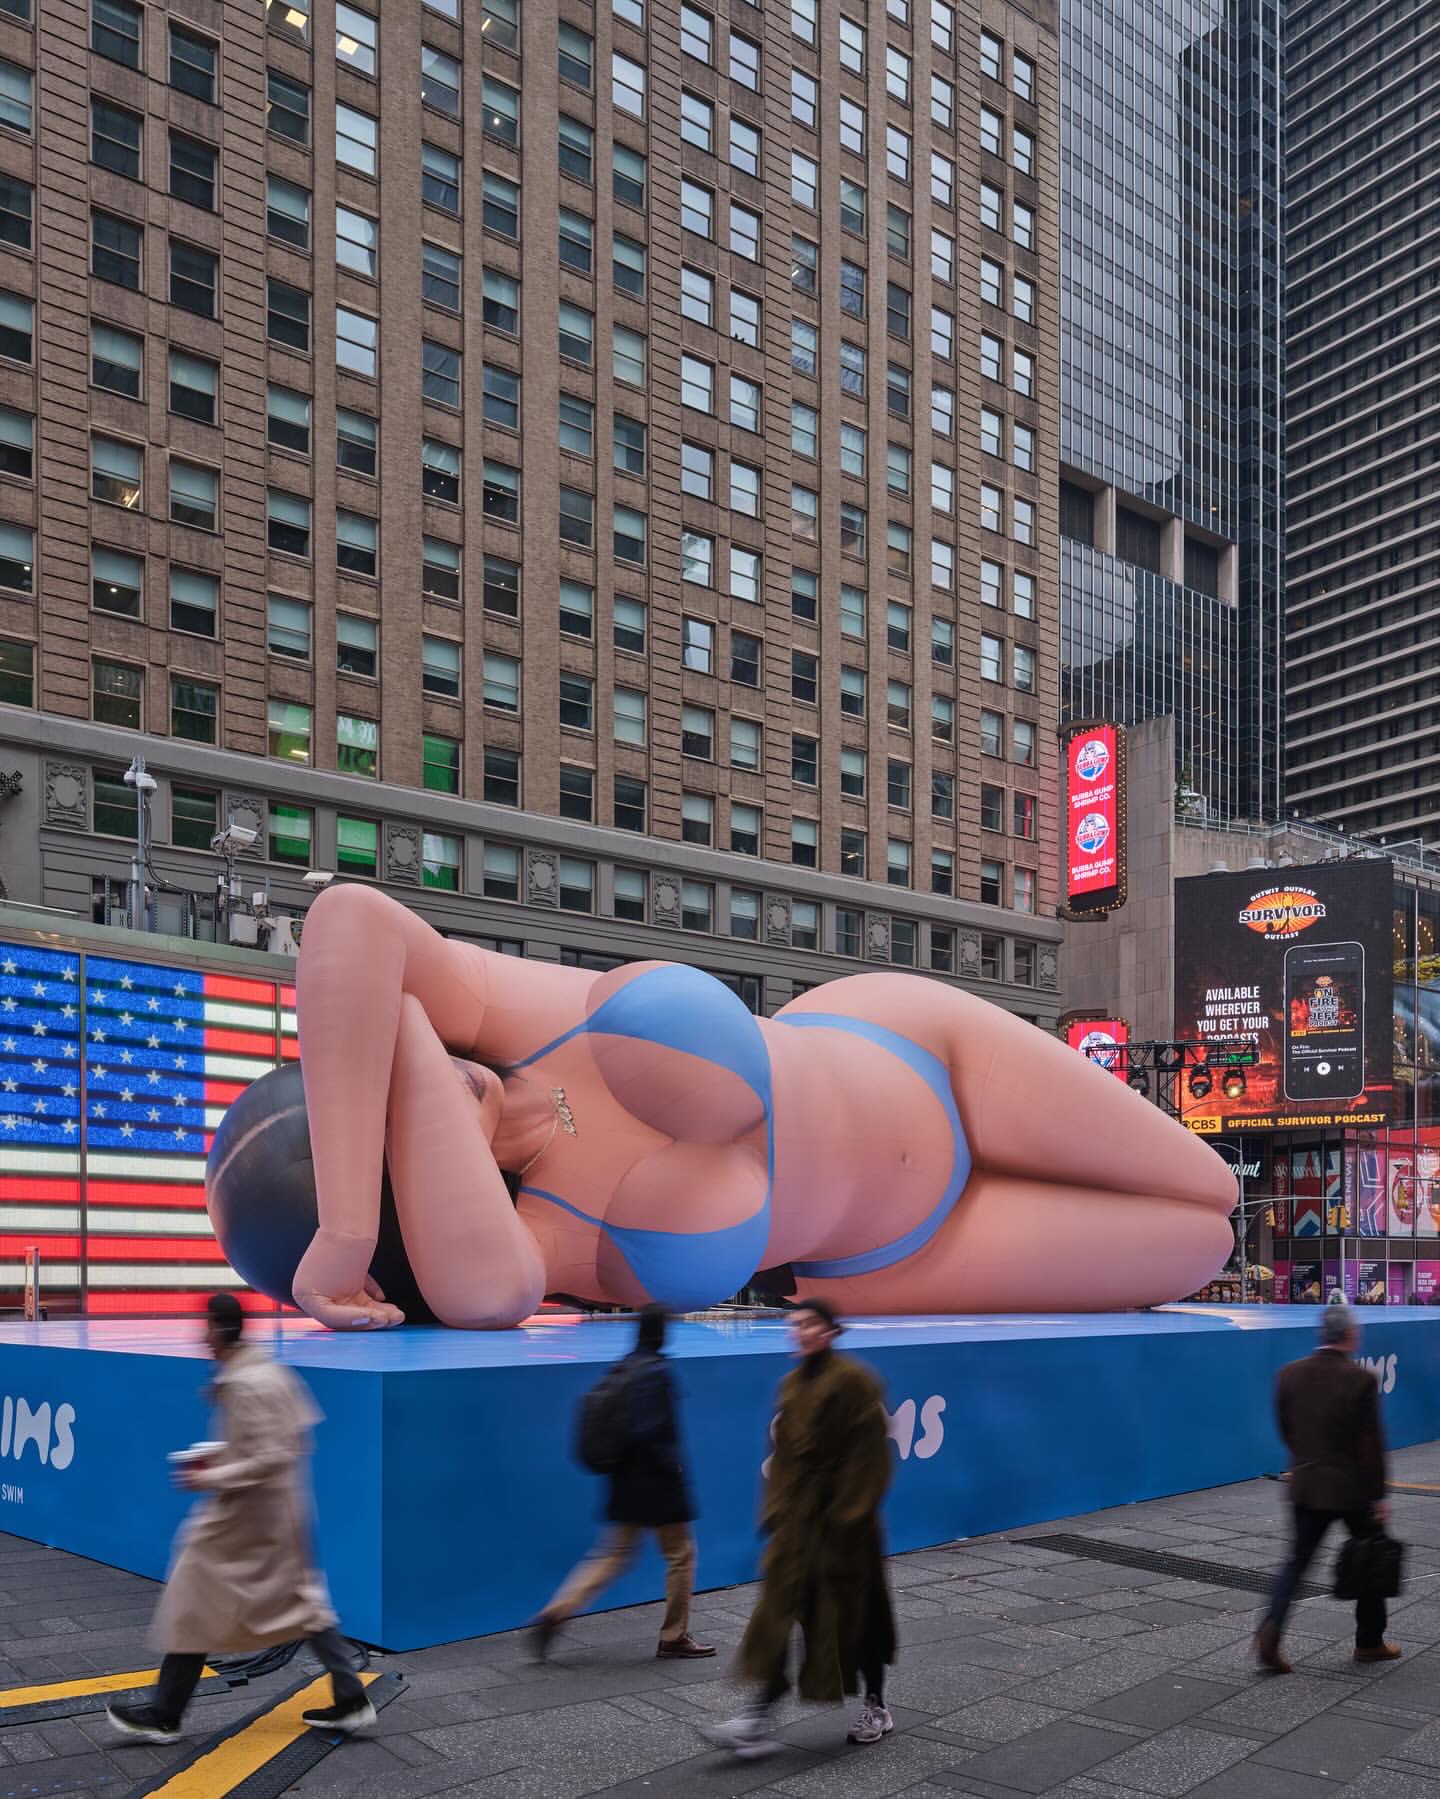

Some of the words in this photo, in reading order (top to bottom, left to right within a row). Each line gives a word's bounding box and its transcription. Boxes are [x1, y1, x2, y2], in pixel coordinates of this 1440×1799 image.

[1094, 784, 1114, 795] GUMP
[1094, 858, 1114, 868] GUMP
[1074, 868, 1098, 880] SHRIMP
[1250, 887, 1279, 901] OUTWIT
[1284, 886, 1317, 897] OUTPLAY
[1239, 903, 1326, 923] SURVIVOR
[1264, 931, 1299, 940] OUTLAST
[1206, 986, 1260, 1001] AVAILABLE
[1205, 1001, 1260, 1016] WHEREVER
[1309, 997, 1338, 1008] FIRE
[1310, 1010, 1338, 1020] JEFF
[1197, 1019, 1217, 1033] YOU
[1220, 1018, 1239, 1031] GET
[1242, 1016, 1269, 1030] YOUR
[1192, 1119, 1217, 1130] CBS
[1228, 1118, 1274, 1128] OFFICIAL
[1277, 1116, 1331, 1127] SURVIVOR
[1334, 1113, 1386, 1124] PODCAST
[1227, 1161, 1260, 1178] ount
[2, 1483, 24, 1504] SWIM
